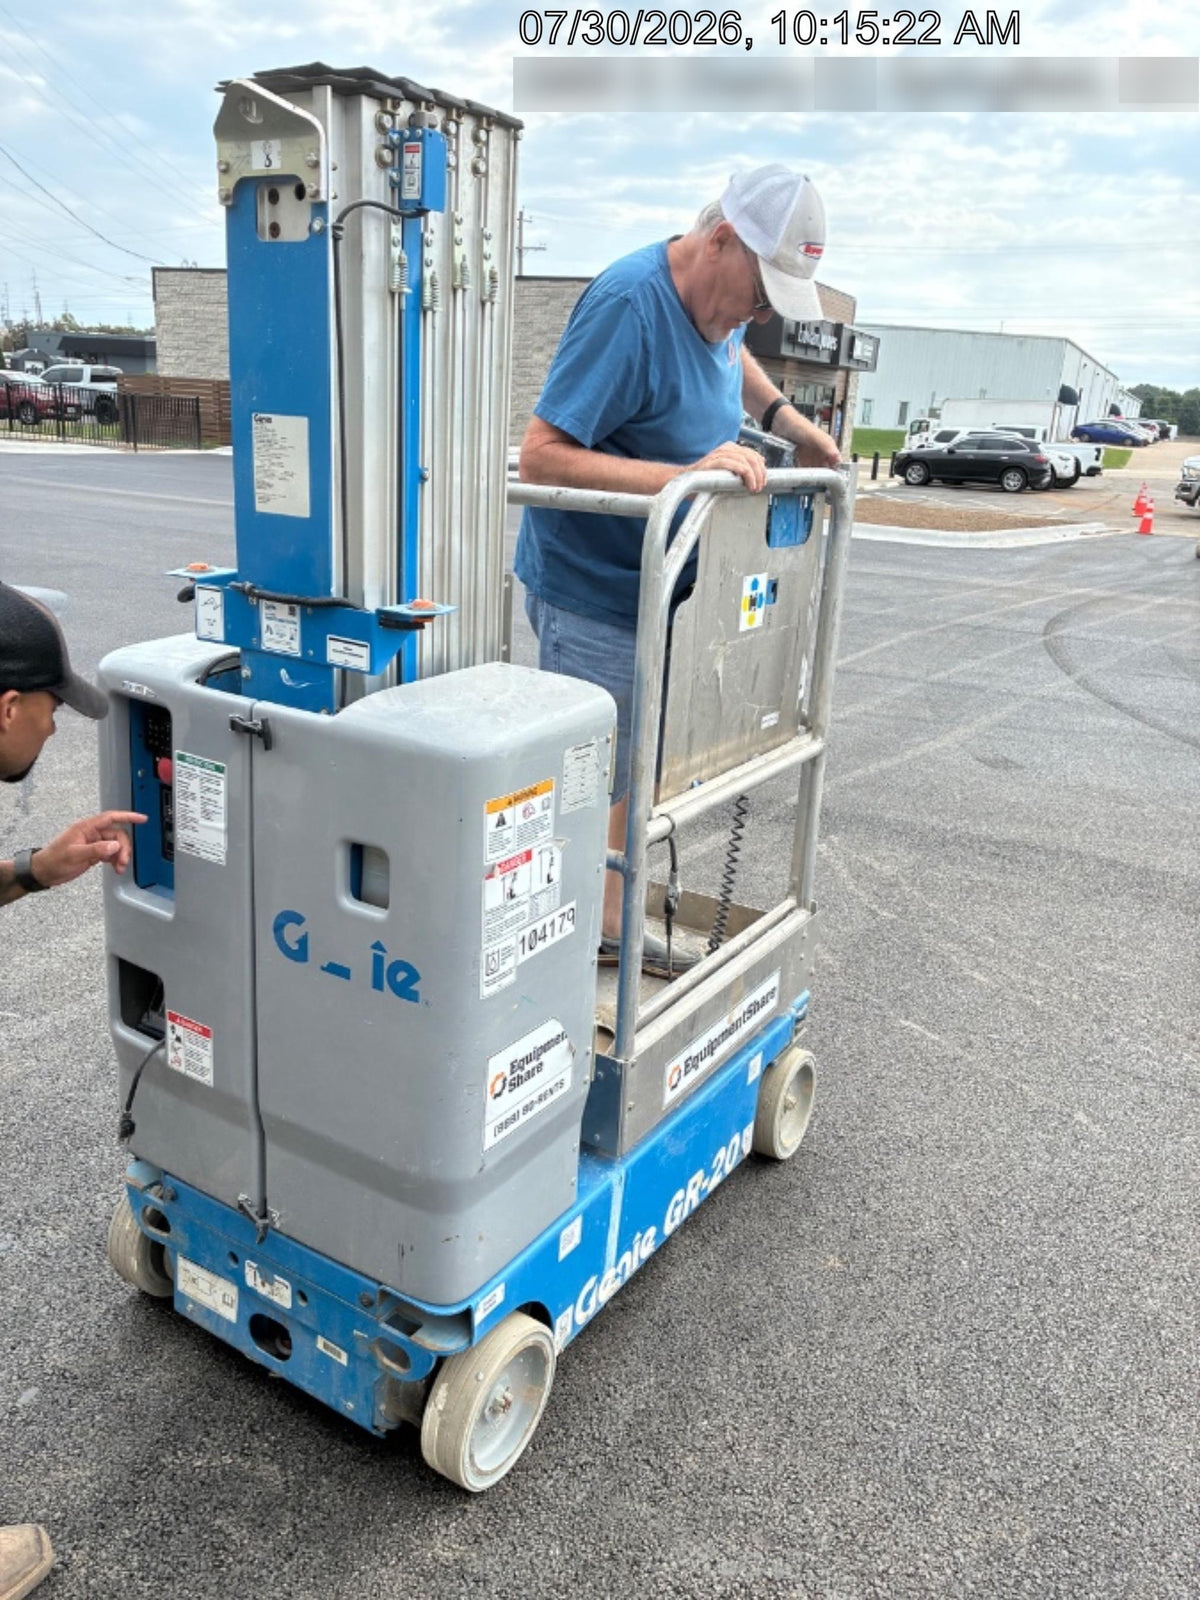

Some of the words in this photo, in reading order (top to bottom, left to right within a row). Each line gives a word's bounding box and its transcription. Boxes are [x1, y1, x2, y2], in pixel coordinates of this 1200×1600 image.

[519, 907, 575, 955] 104179
[508, 1061, 543, 1092] Share
[575, 1226, 657, 1325] Genie
[663, 1132, 741, 1236] GR-20
